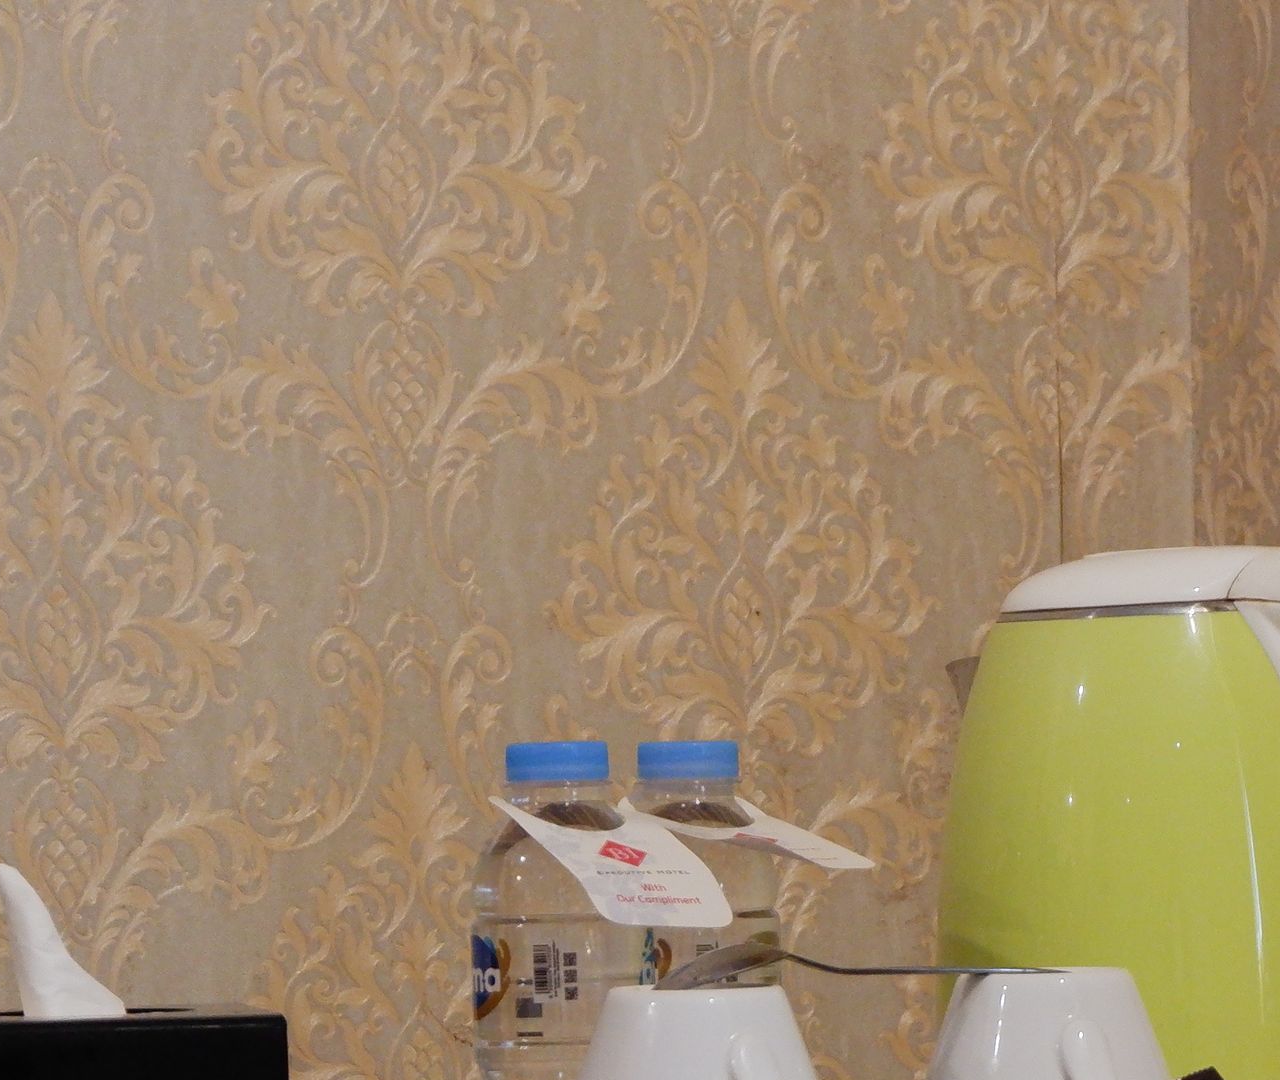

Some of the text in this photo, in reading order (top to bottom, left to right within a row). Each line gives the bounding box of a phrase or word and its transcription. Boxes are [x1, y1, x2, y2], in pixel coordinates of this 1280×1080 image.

[641, 882, 668, 892] With
[616, 894, 702, 906] Our Compliment
